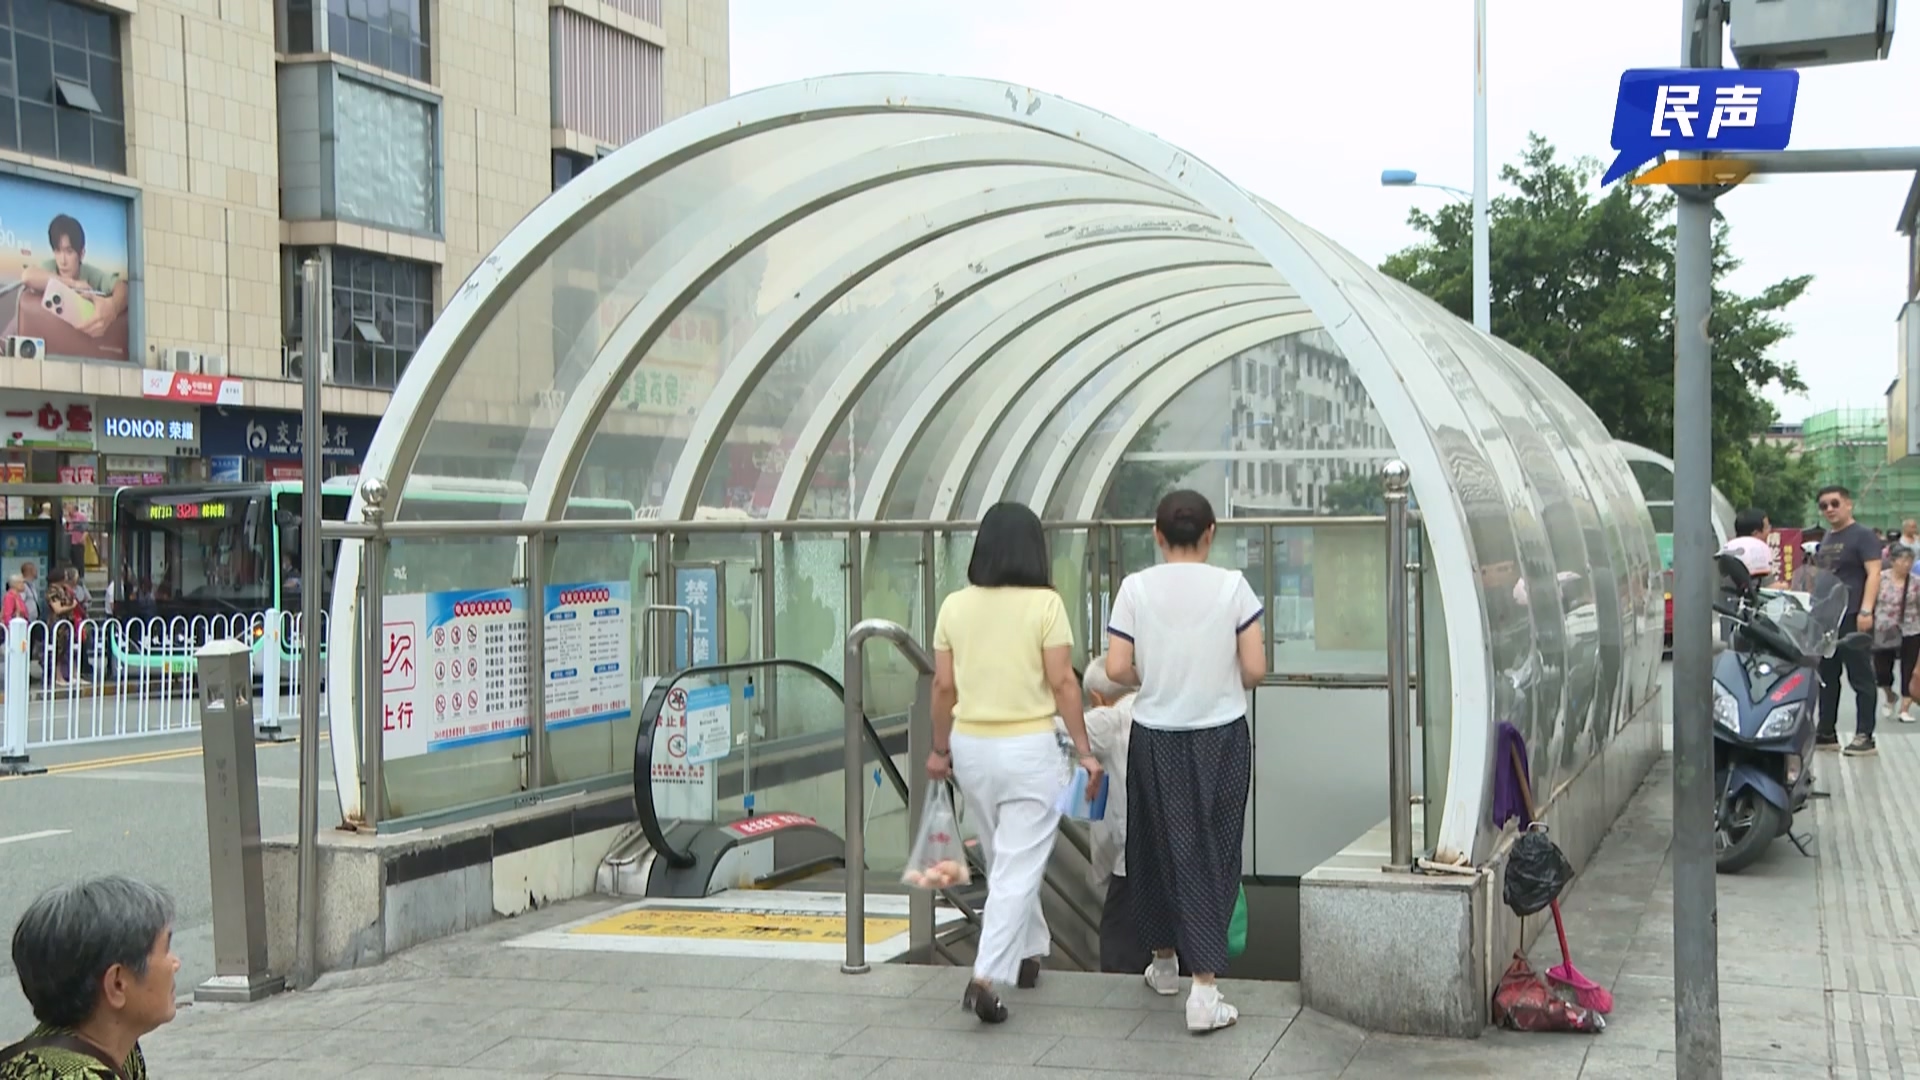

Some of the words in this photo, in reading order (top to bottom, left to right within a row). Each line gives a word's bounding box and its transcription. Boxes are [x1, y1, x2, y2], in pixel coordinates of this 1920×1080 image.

[5, 403, 93, 433] 一心堂
[106, 417, 164, 438] HONOR
[168, 421, 194, 440] 荣耀
[269, 445, 288, 454] BANK
[289, 445, 299, 454] OF
[383, 702, 414, 731] 上行
